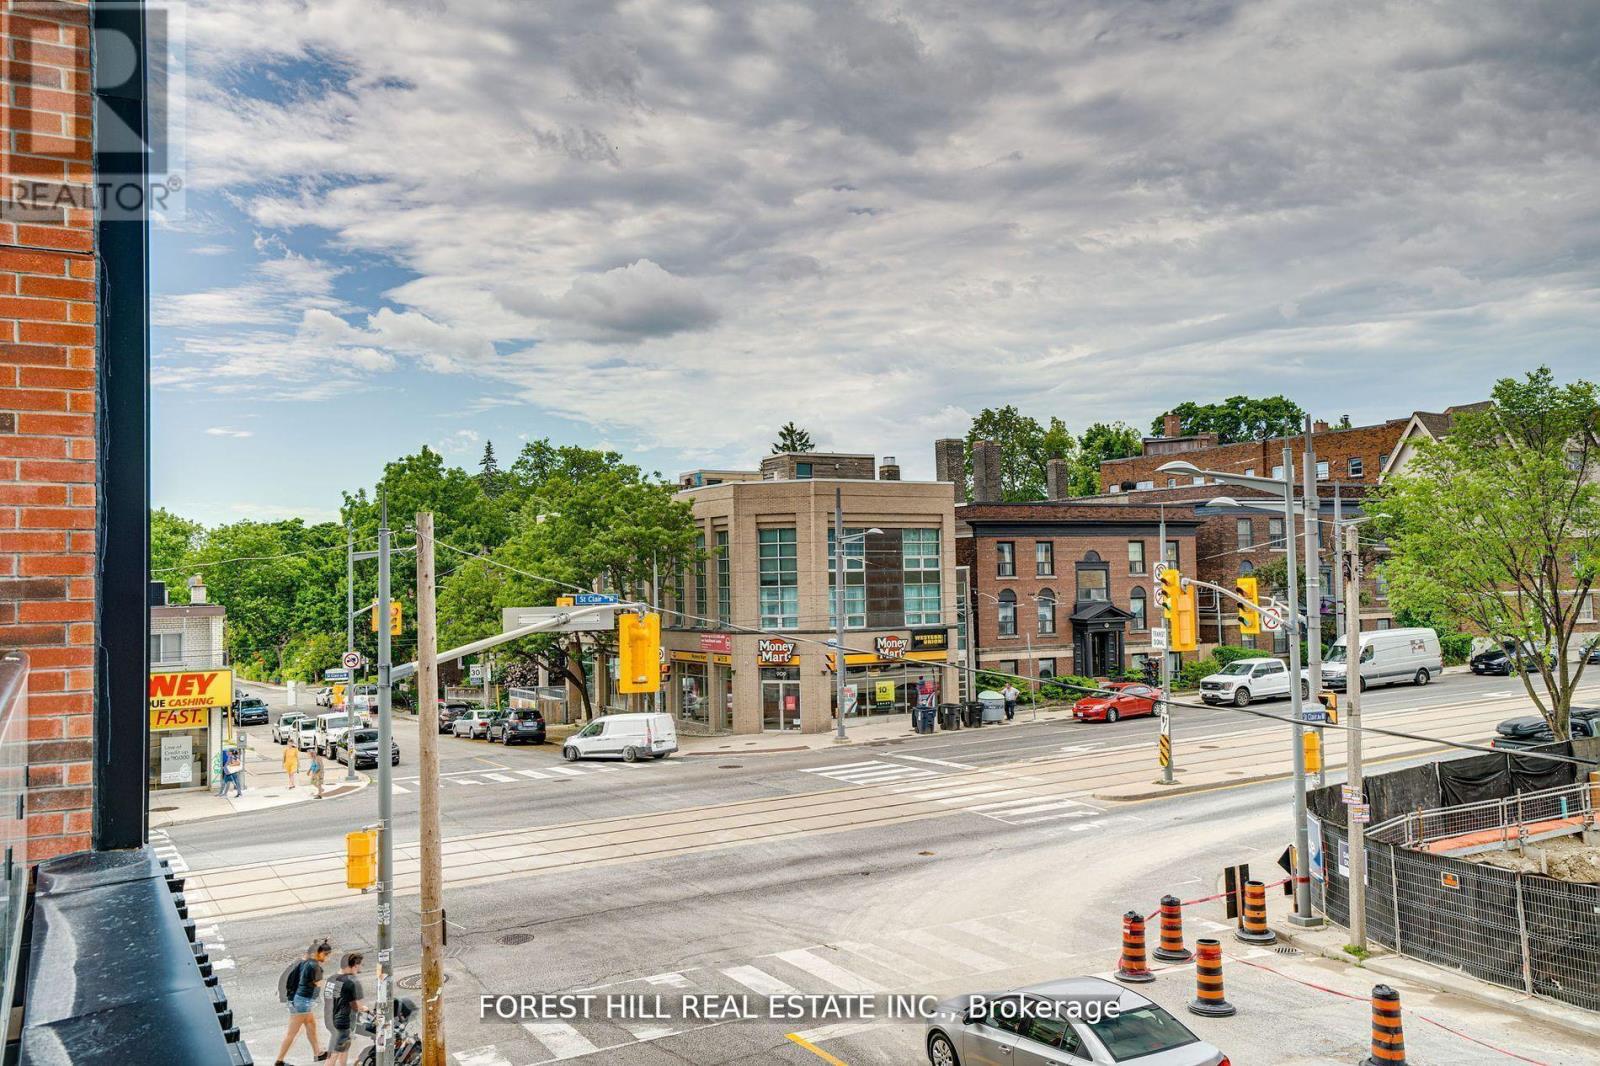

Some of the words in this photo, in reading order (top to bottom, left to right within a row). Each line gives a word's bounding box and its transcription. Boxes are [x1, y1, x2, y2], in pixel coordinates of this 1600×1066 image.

[579, 595, 587, 603] St
[588, 594, 602, 603] Clair
[759, 640, 795, 654] Money
[877, 637, 907, 651] Money
[762, 651, 790, 662] Mart
[880, 648, 903, 659] Mart
[168, 697, 214, 707] CASHING
[157, 708, 202, 725] FAST.
